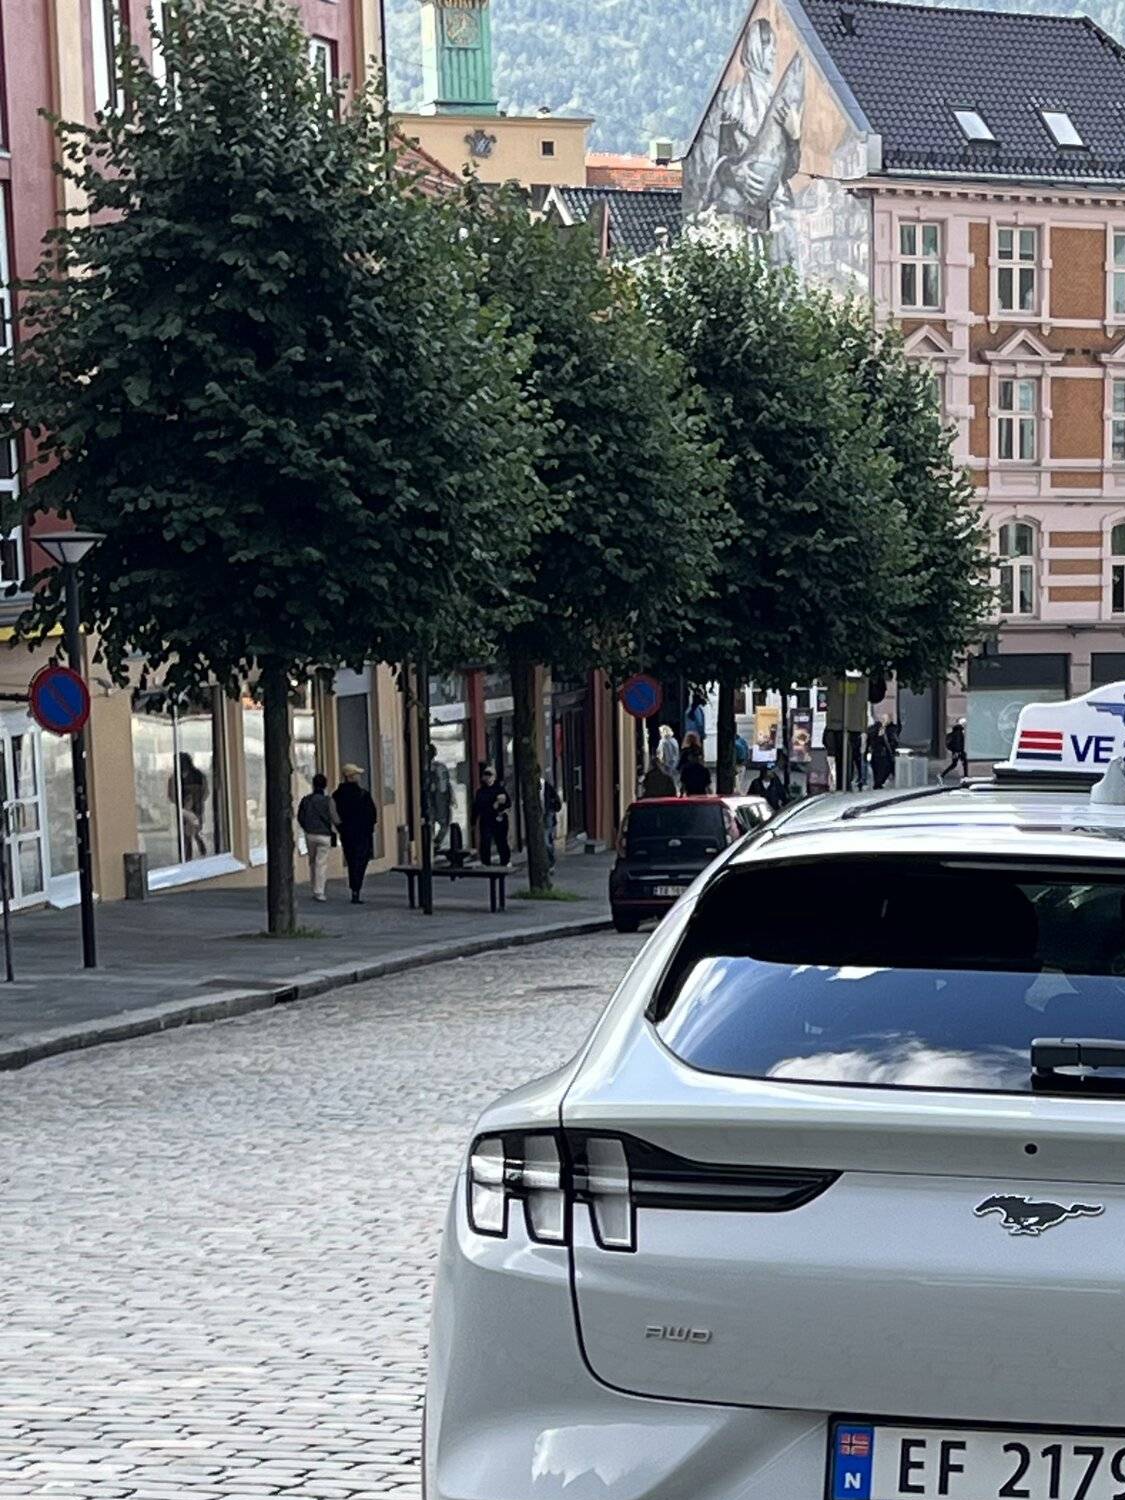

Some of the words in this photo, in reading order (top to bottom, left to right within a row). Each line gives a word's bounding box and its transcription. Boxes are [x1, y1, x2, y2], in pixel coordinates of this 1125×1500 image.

[1071, 734, 1115, 763] VE
[644, 1325, 710, 1342] AWD
[898, 1438, 966, 1495] EF
[844, 1472, 861, 1489] N
